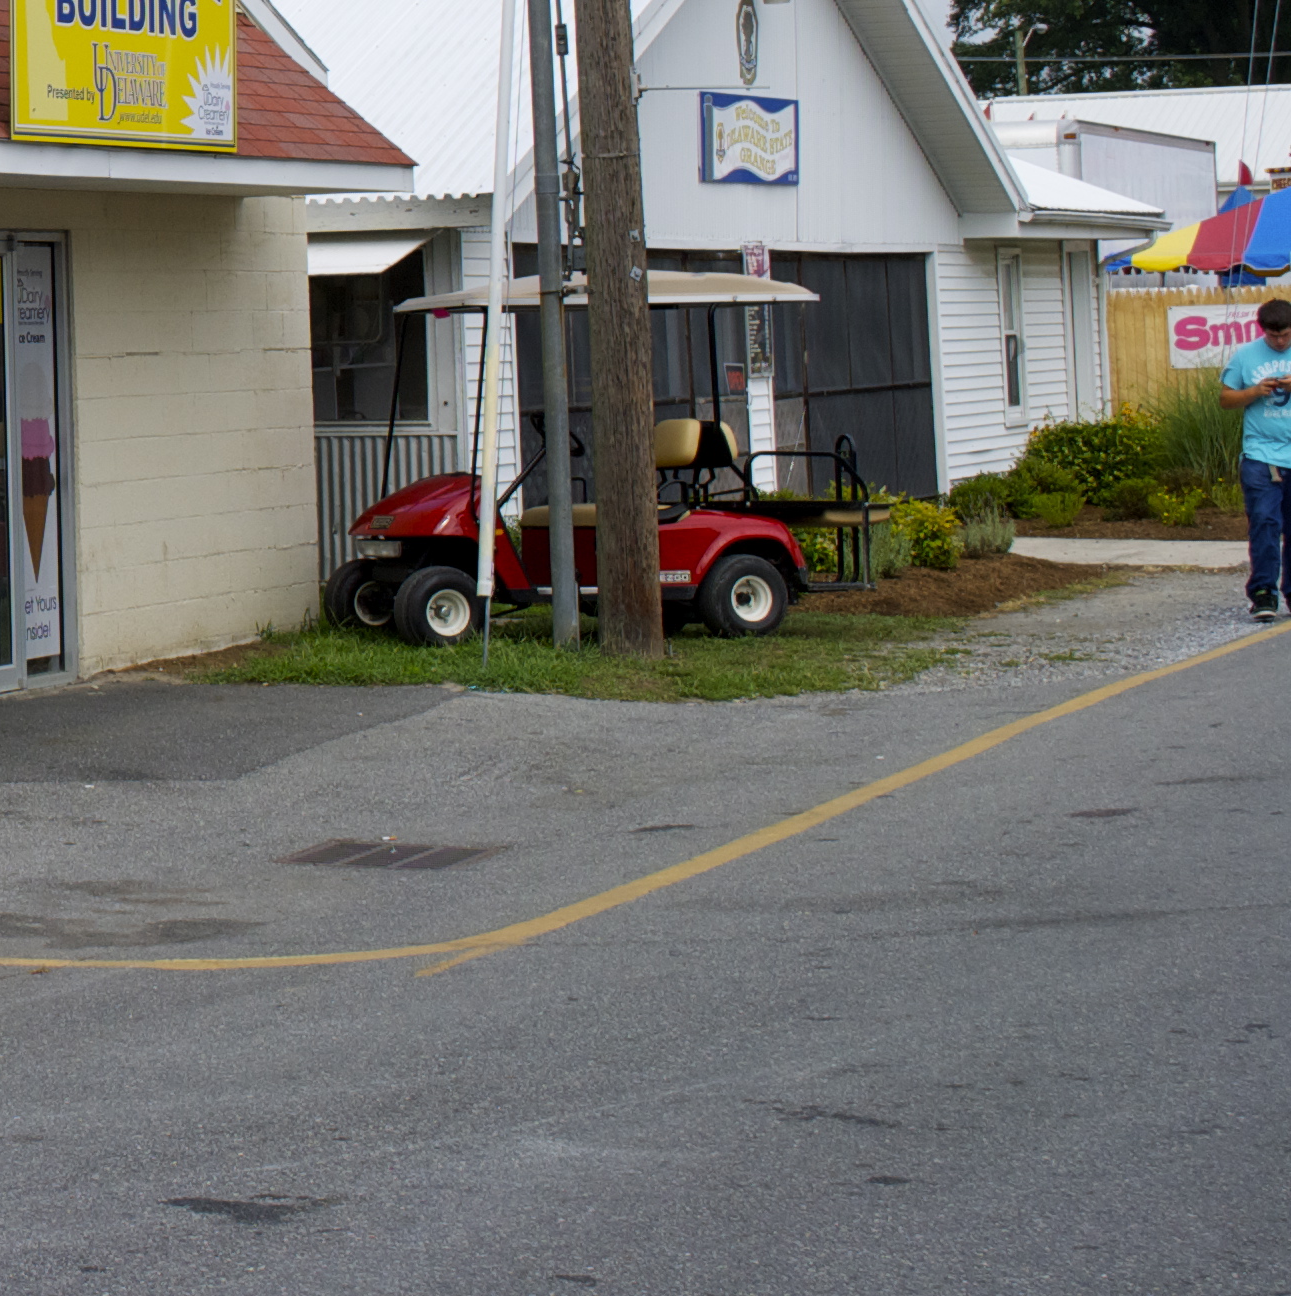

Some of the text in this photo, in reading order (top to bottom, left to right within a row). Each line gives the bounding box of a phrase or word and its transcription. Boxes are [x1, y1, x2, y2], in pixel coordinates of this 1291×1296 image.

[47, 84, 95, 105] Presented by
[740, 147, 775, 175] GRANGE
[17, 307, 50, 323] reamery
[25, 595, 57, 614] et Yours
[26, 620, 51, 641] nside!
